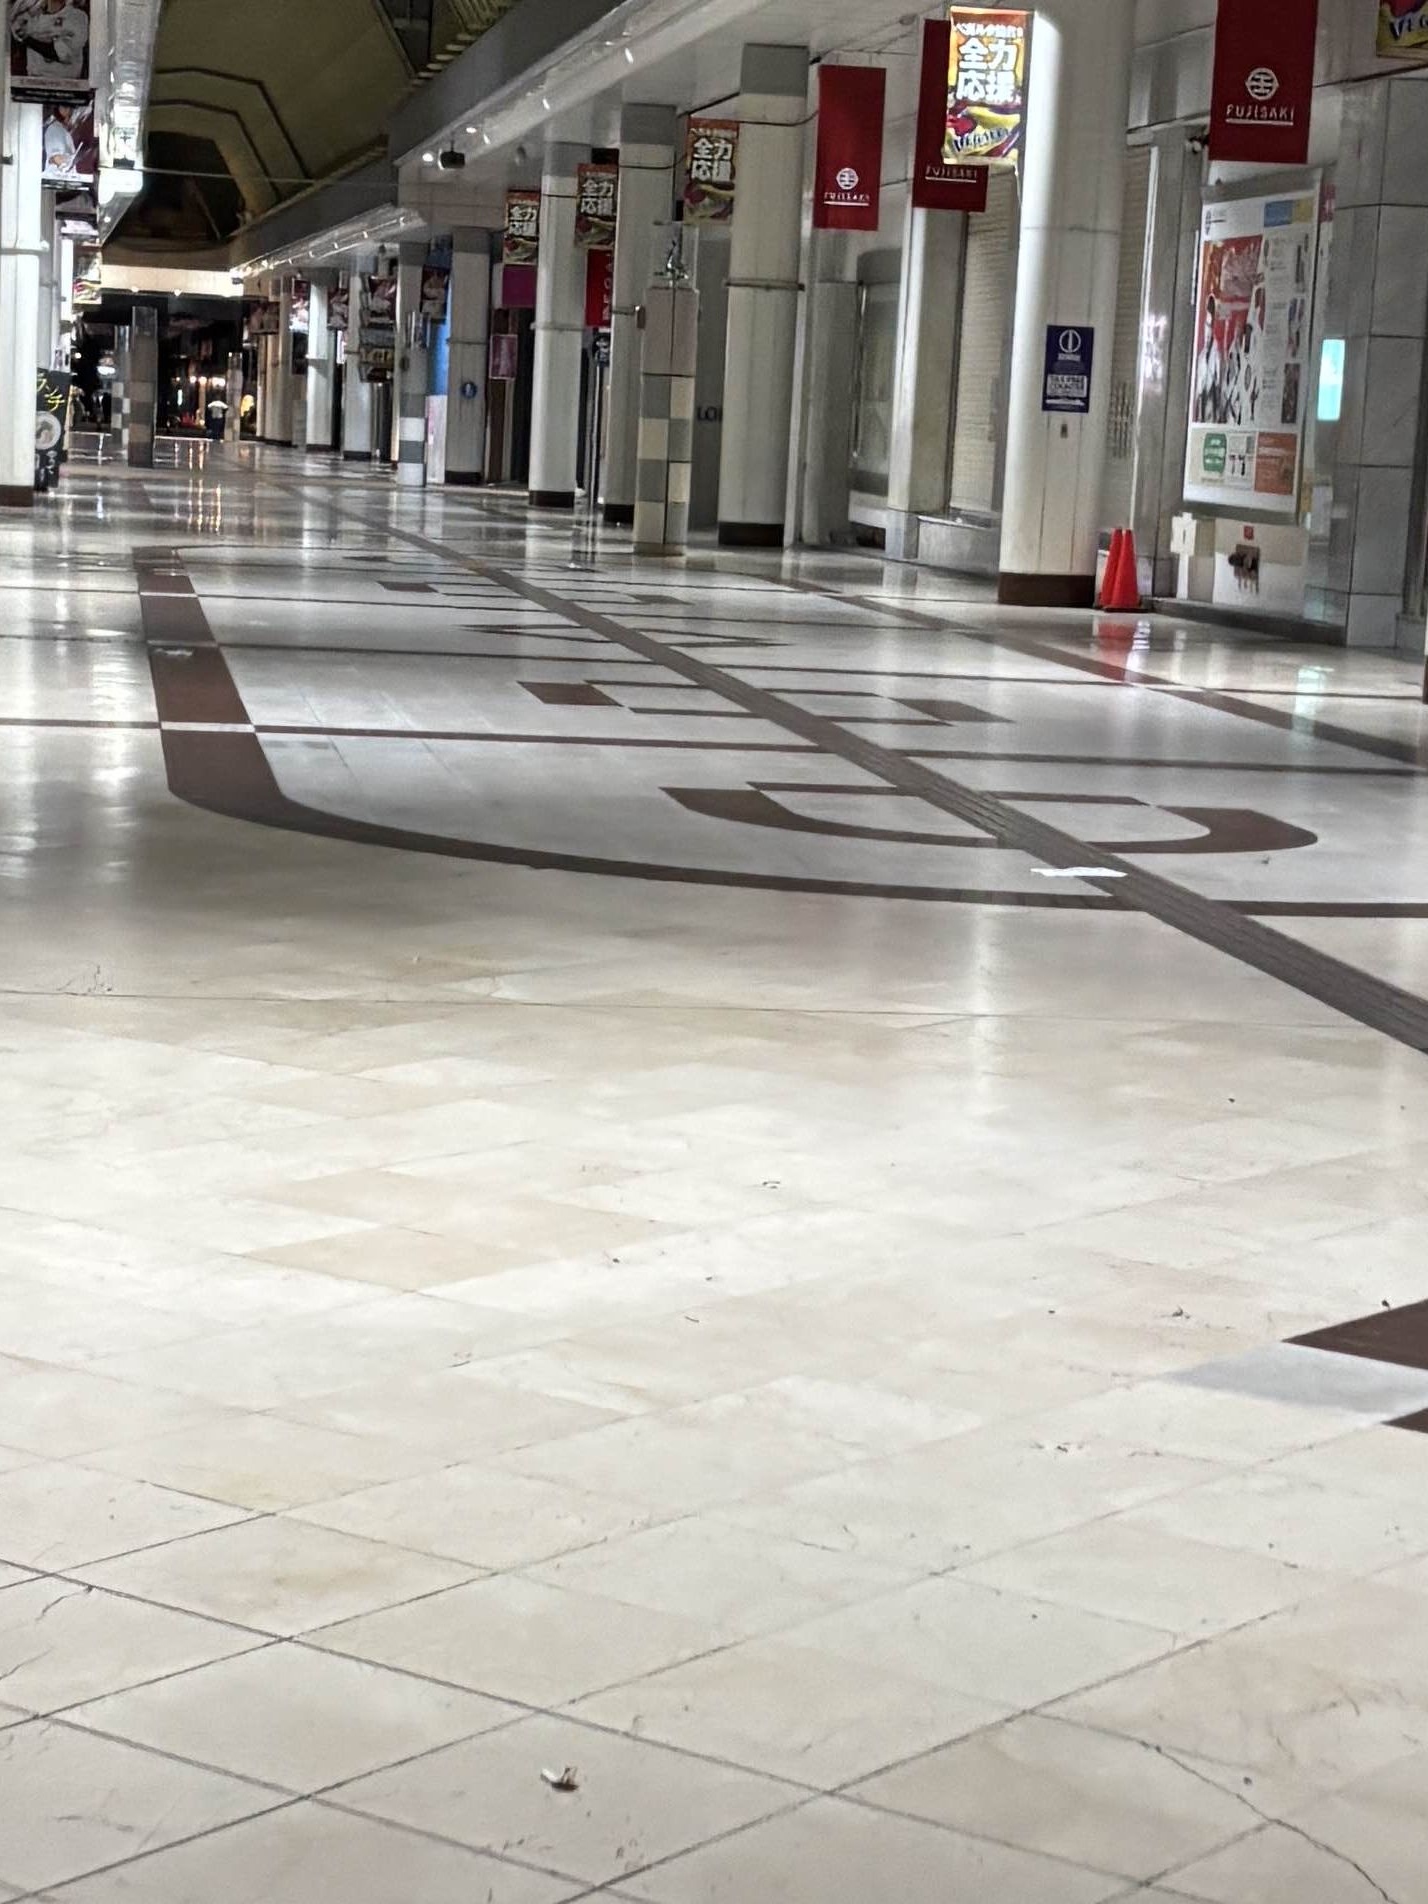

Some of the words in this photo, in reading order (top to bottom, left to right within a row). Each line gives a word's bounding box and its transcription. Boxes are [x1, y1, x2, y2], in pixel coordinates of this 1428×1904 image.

[958, 37, 1018, 71] 全力
[1225, 103, 1295, 121] FUJISAKI
[692, 137, 733, 160] 全力
[581, 180, 615, 198] 全力
[508, 205, 536, 221] 全力
